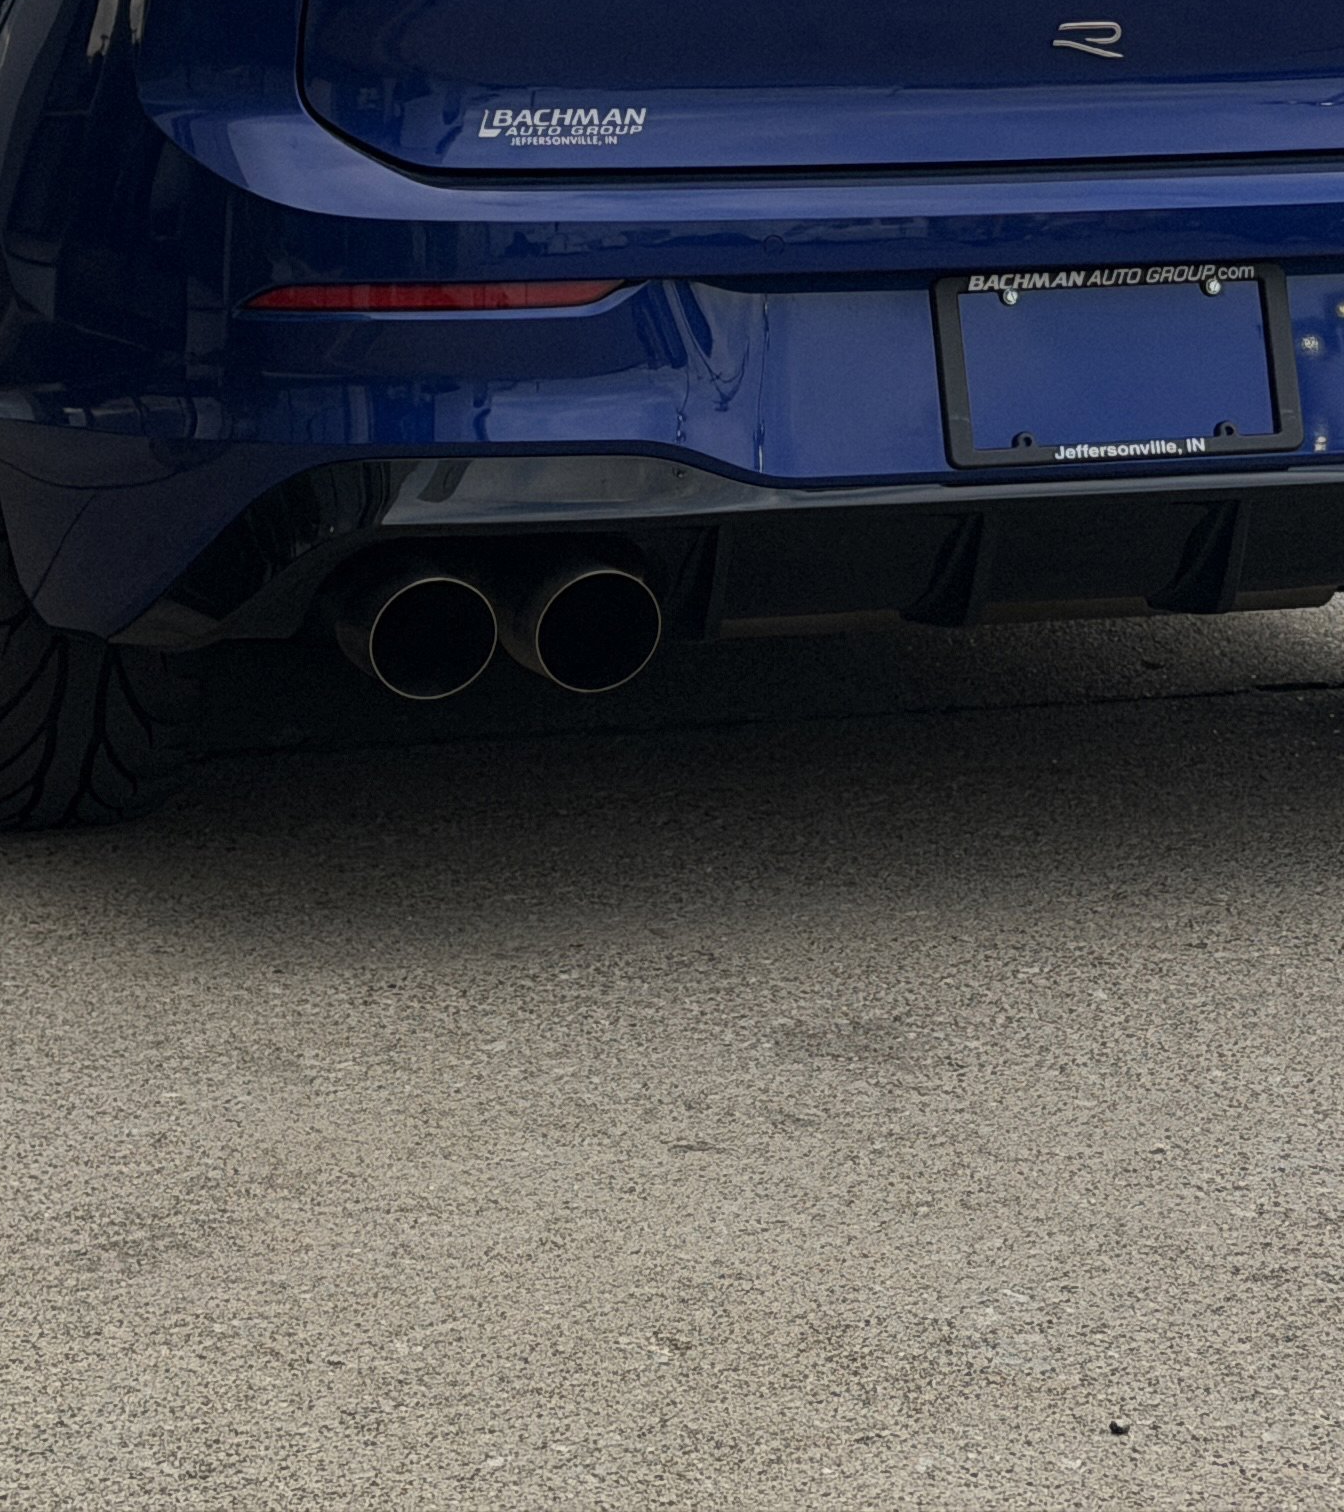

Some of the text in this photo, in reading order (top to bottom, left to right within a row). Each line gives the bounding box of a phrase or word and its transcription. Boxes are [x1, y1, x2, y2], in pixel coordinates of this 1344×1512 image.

[493, 108, 647, 127] BACHMAN
[505, 126, 643, 137] AUTO GROUP
[510, 136, 618, 147] JEFFERSONVILLE, IN
[968, 271, 1086, 291] BACHMAN
[1086, 268, 1141, 287] AUTO
[1054, 438, 1206, 460] Jeffersonville, IN
